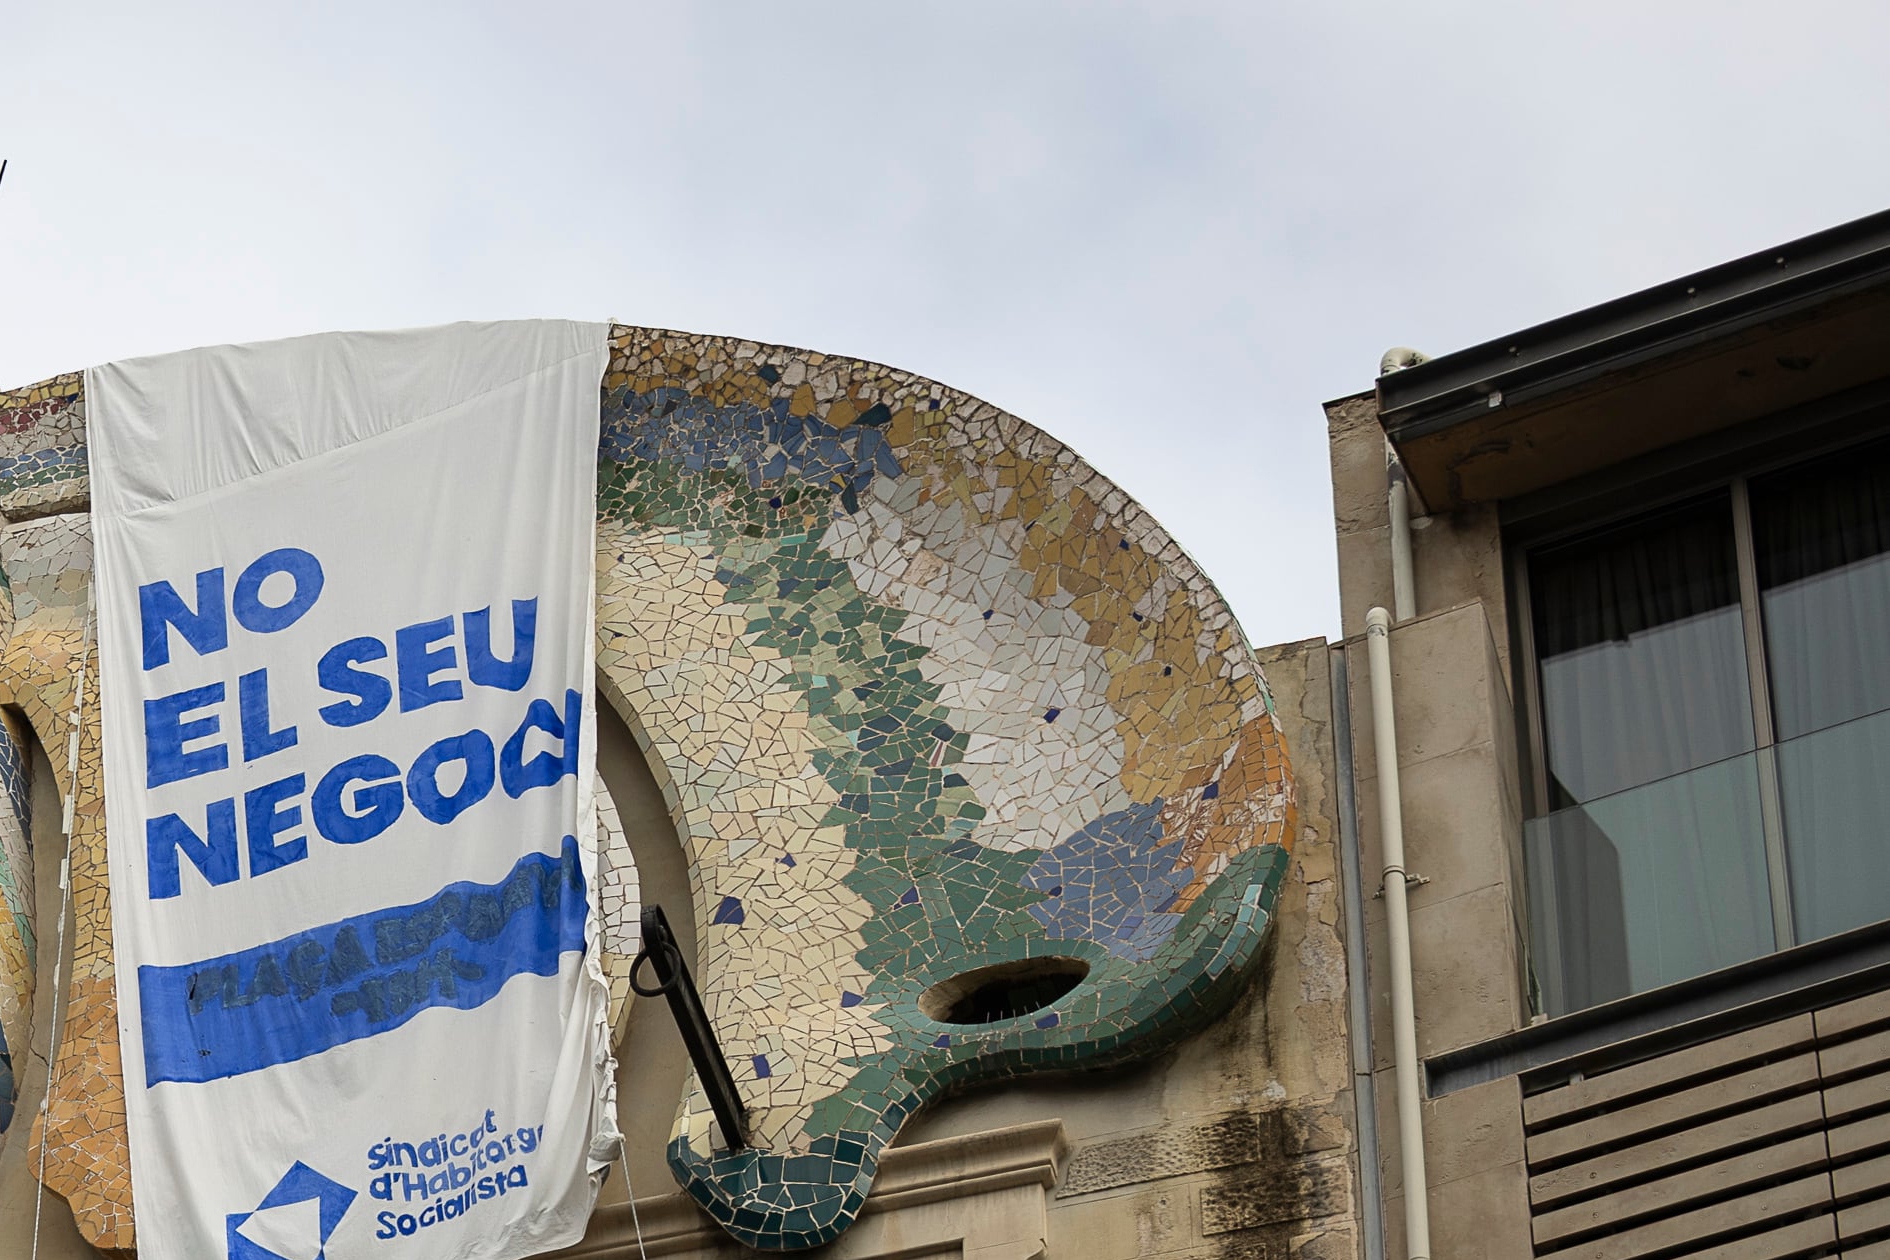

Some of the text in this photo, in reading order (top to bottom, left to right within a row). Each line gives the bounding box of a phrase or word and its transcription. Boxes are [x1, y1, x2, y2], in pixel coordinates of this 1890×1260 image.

[139, 547, 324, 670] NO
[144, 596, 538, 789] EL SEU
[368, 1108, 497, 1170] sindicat
[376, 1165, 528, 1240] Socialista
